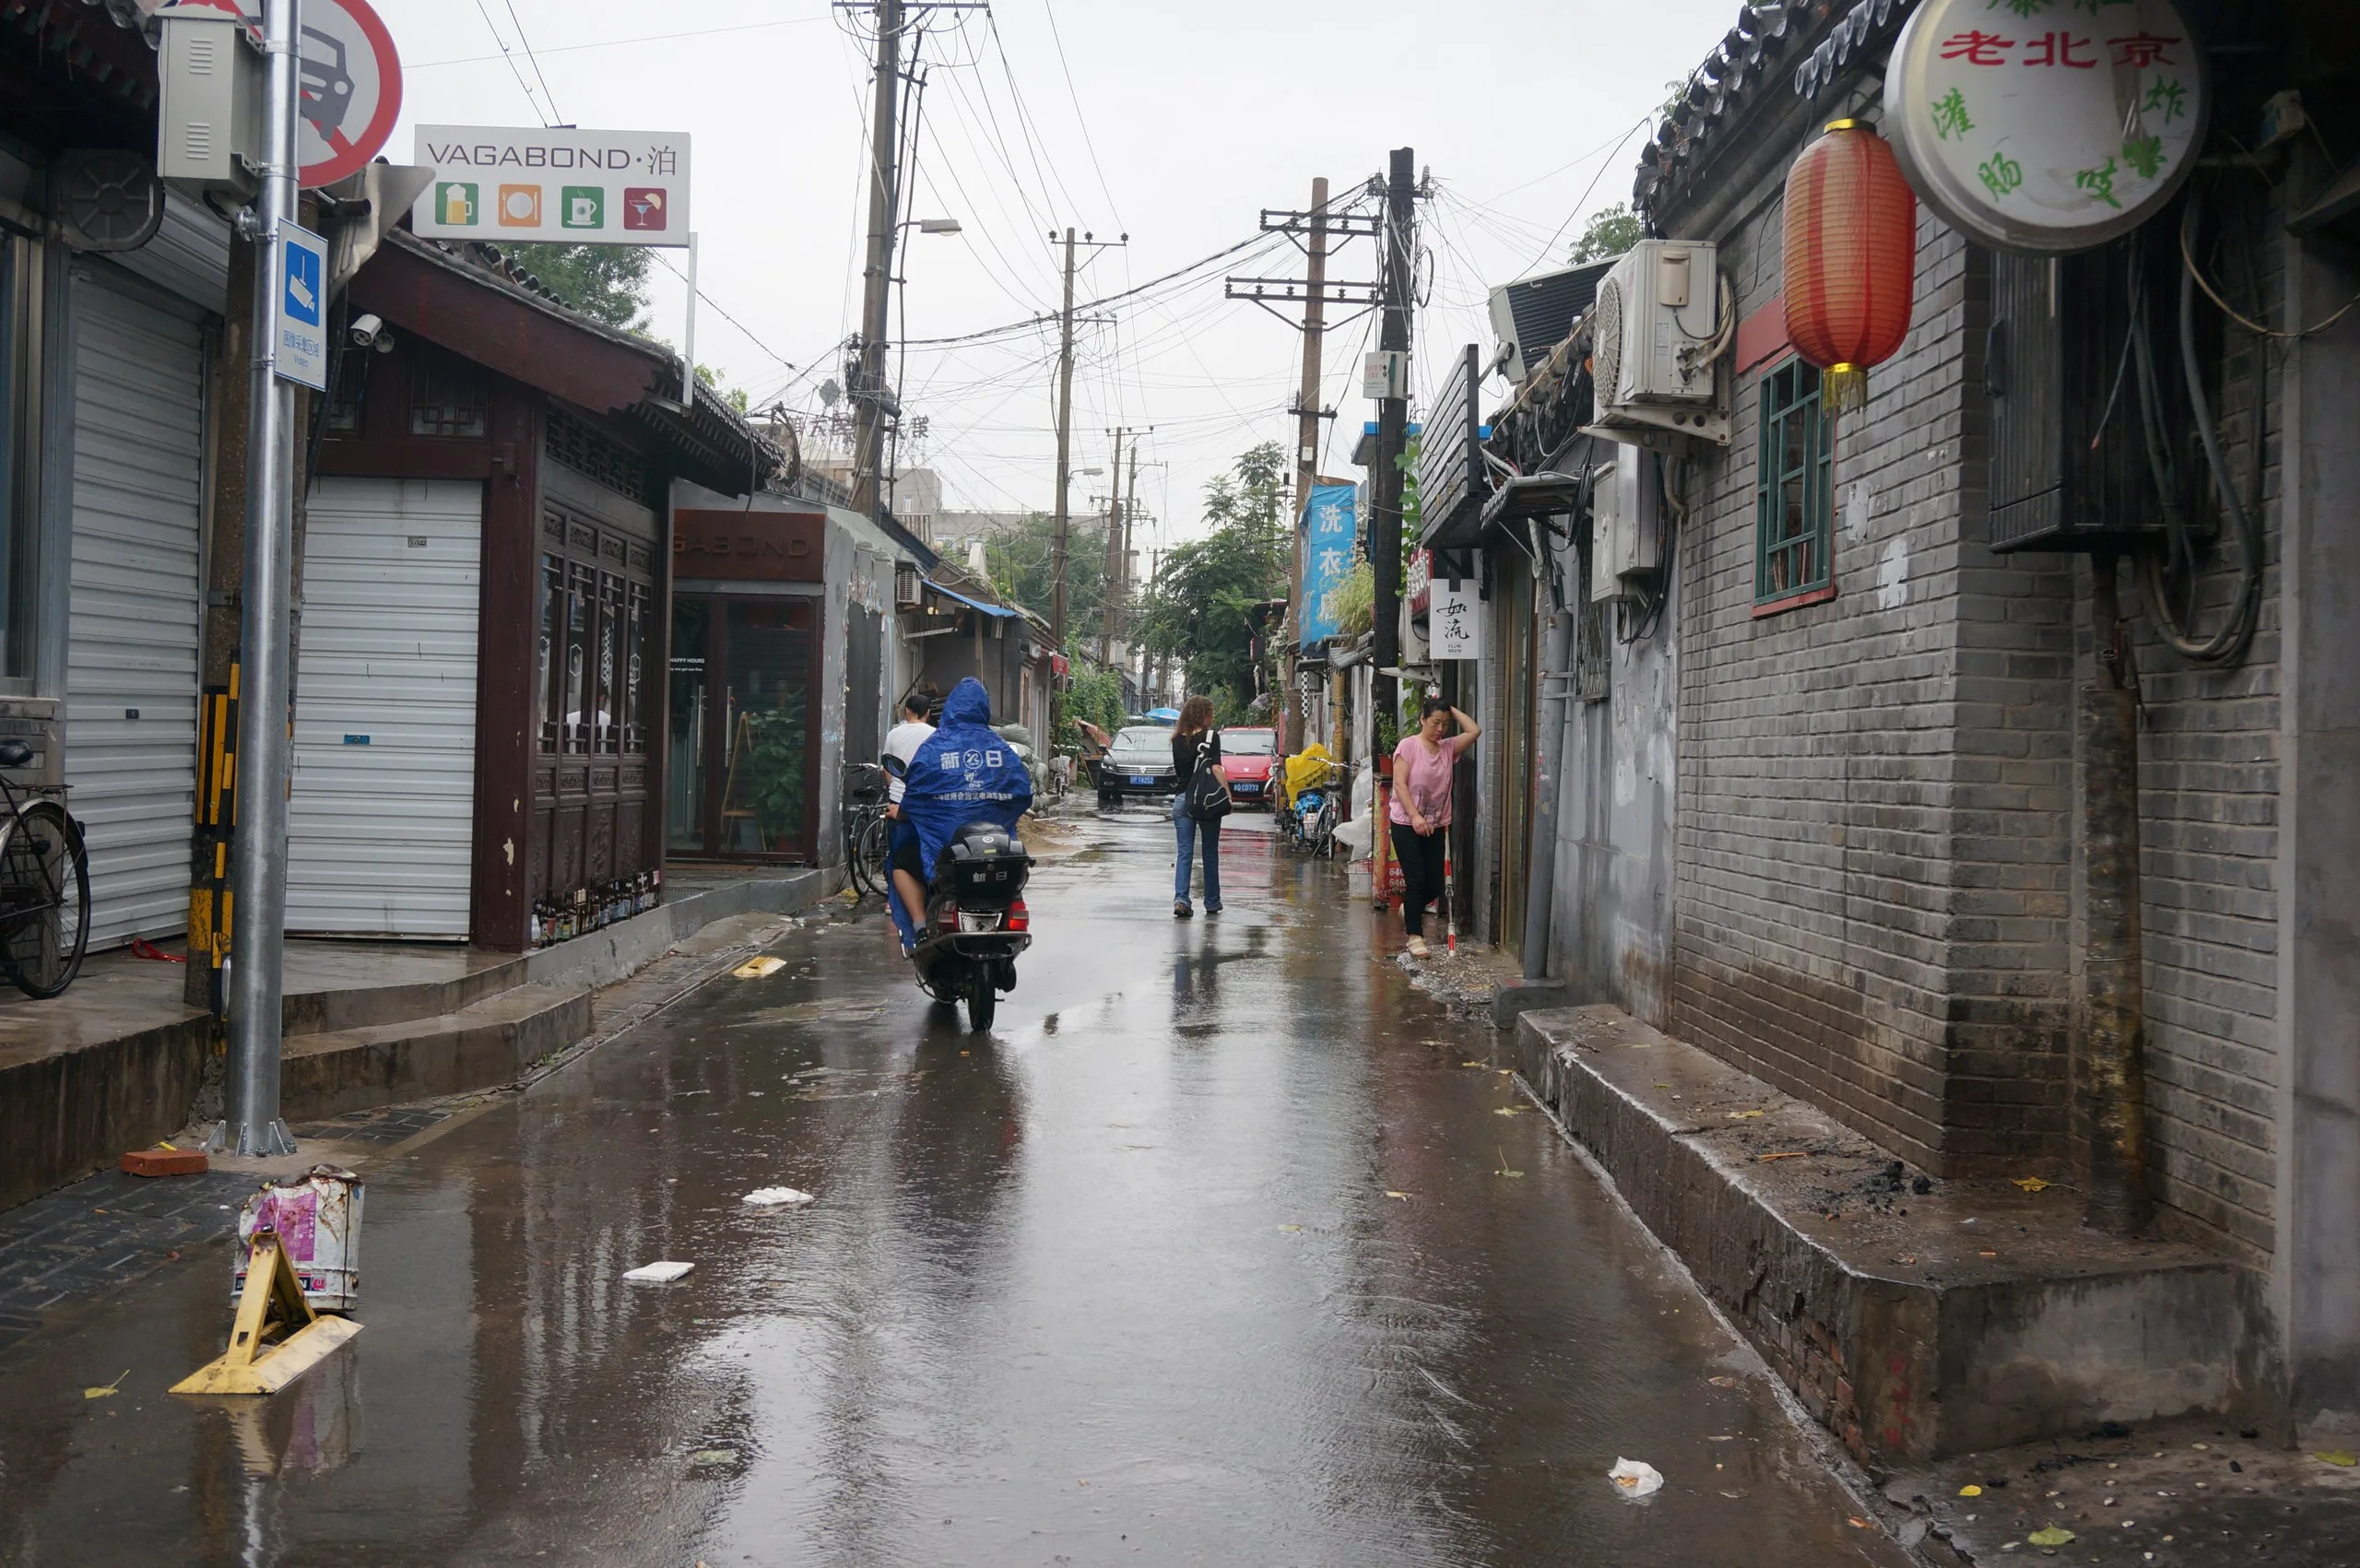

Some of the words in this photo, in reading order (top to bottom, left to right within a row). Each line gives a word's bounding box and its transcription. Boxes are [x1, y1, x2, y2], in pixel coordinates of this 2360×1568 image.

[1939, 29, 2182, 68] 老北京
[293, 353, 310, 369] Video
